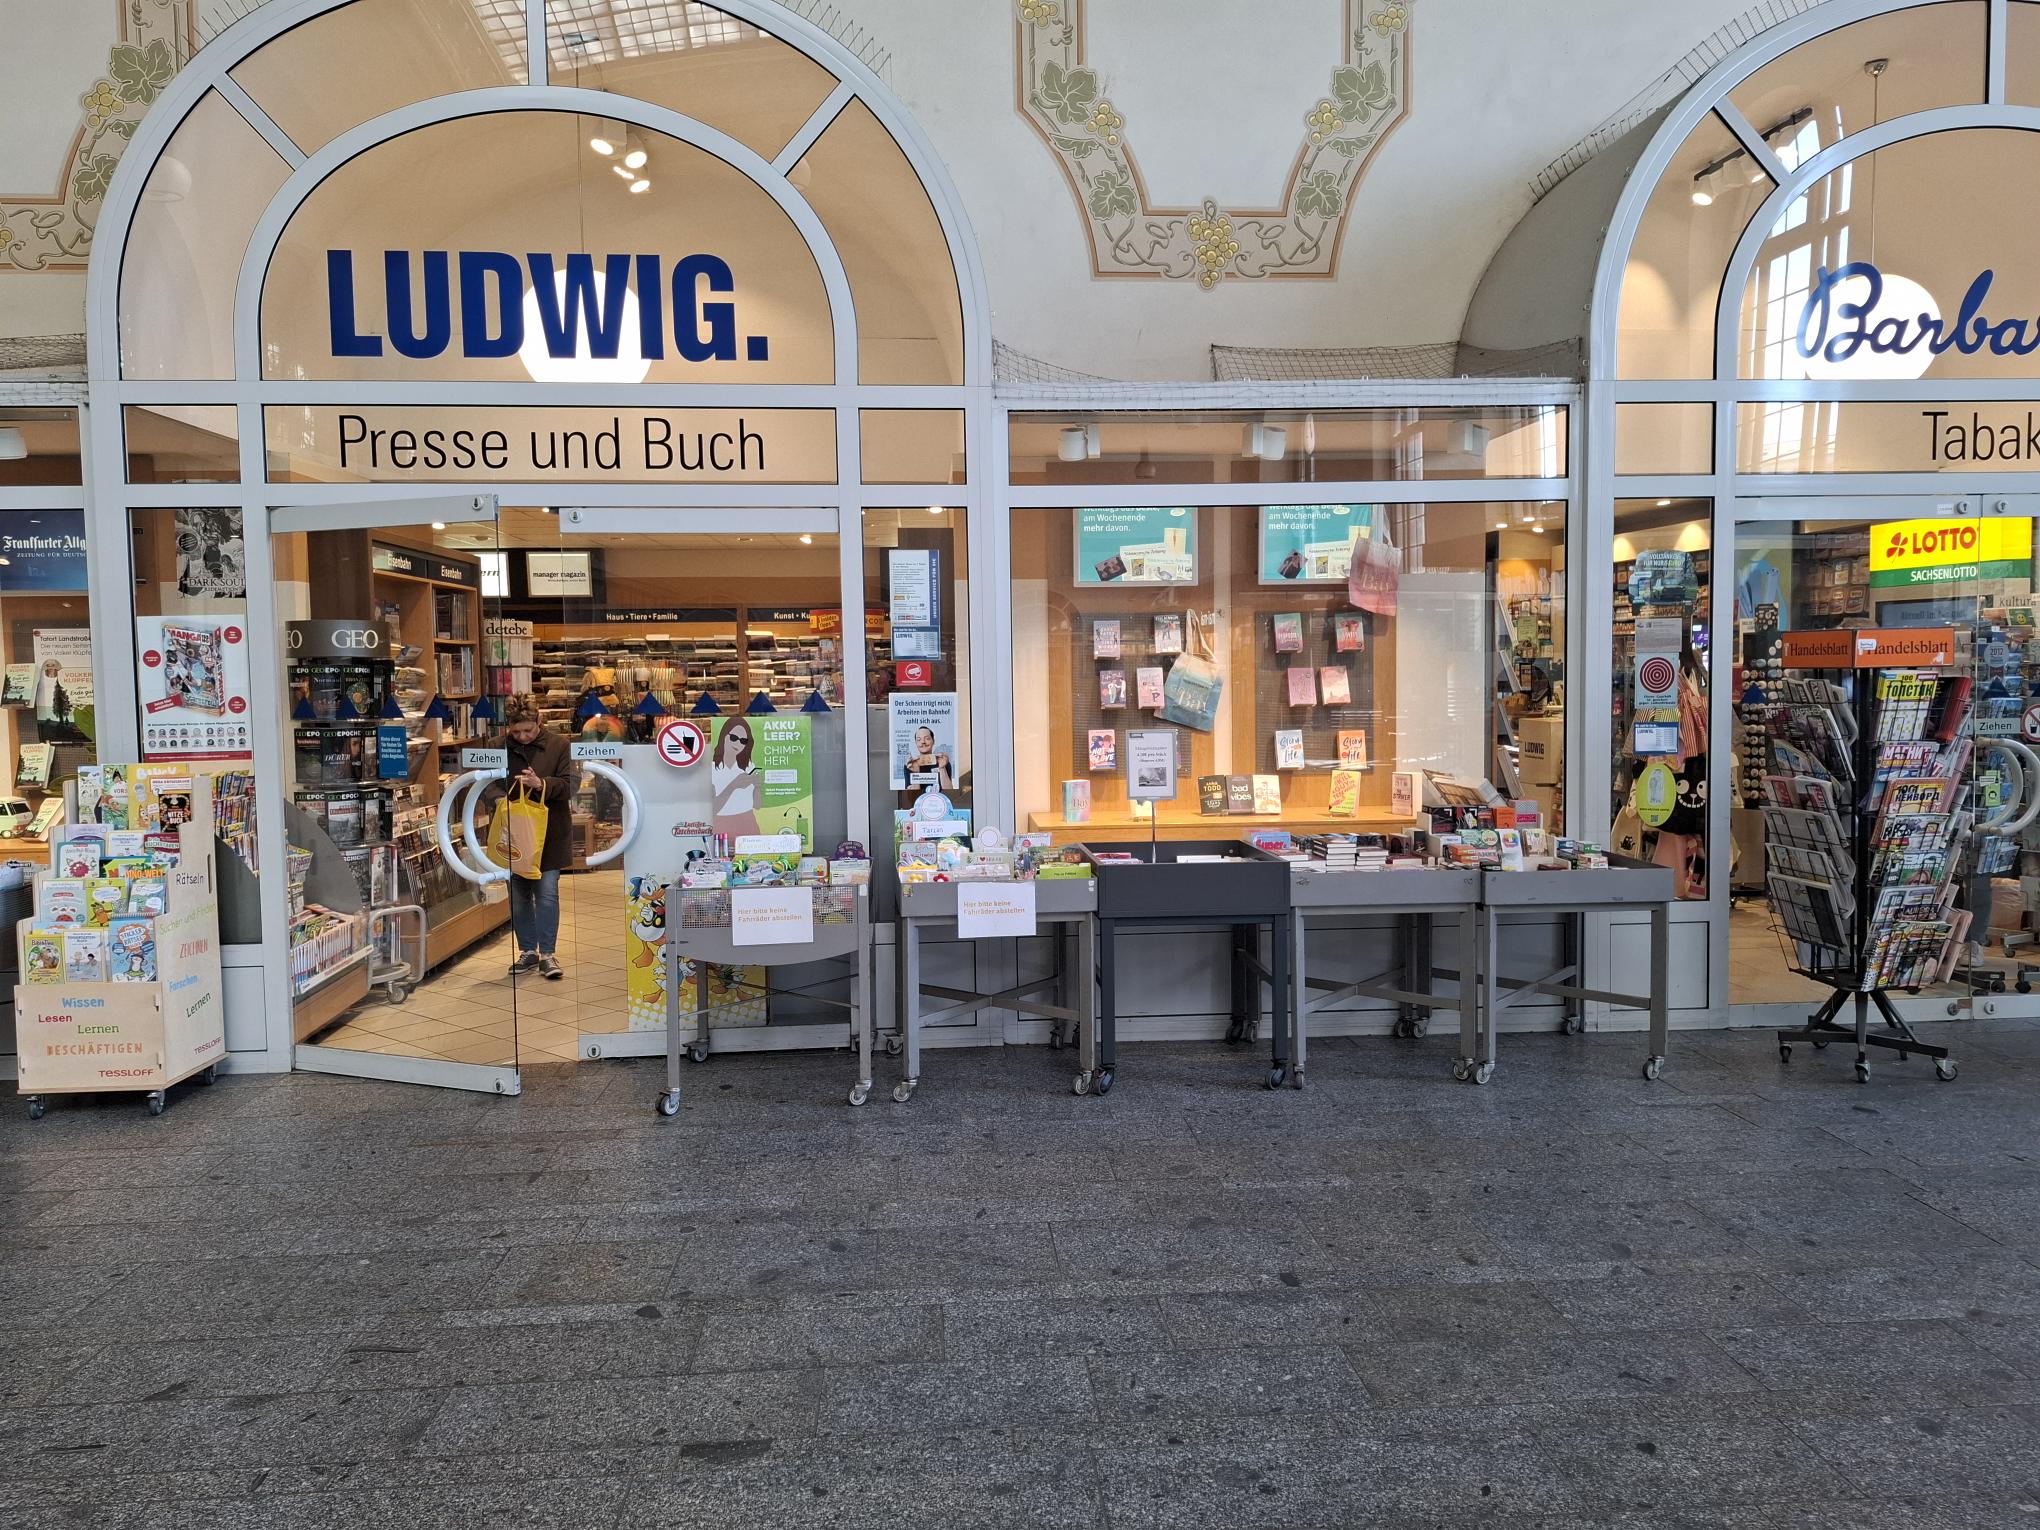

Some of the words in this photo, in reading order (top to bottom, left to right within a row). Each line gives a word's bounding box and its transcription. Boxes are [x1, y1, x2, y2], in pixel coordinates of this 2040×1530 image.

[326, 249, 769, 362] LUDWIG.
[1795, 261, 2040, 363] Barba
[337, 414, 509, 469] Presse
[530, 417, 621, 470] und
[643, 416, 766, 471] Buch
[1096, 513, 1146, 522] Wochenende
[1282, 512, 1331, 520] Wochenende
[1084, 524, 1104, 532] mehr
[1105, 524, 1131, 532] davon.
[1268, 522, 1289, 530] mehr
[1912, 526, 1977, 554] LOTTO
[387, 553, 412, 571] Eisenbahn
[441, 565, 462, 580] Eisenbahn
[533, 571, 559, 579] manager
[560, 570, 586, 578] magazin
[1911, 565, 1977, 582] SACHSENLOTTO
[189, 578, 218, 587] DARK
[606, 613, 625, 621] Haus
[629, 613, 648, 621] Tiere
[653, 613, 678, 621] Familie
[773, 612, 795, 620] Kunst
[485, 622, 528, 635] detebe
[331, 629, 379, 649] GEO
[1789, 641, 1849, 657] Handelsblatt
[928, 708, 951, 716] Bahnhof
[764, 721, 796, 730] AKKU
[905, 717, 919, 725] zahlt
[1980, 722, 2012, 731] Ziehen
[764, 731, 801, 742] LEER?
[577, 746, 616, 756] Ziehen
[764, 745, 806, 755] CHIMPY
[1524, 741, 1545, 755] LUDWIG
[469, 753, 502, 764] Ziehen
[1231, 784, 1249, 792] bad
[1230, 792, 1252, 801] vibes
[674, 826, 713, 835] Taschenbuch
[176, 872, 204, 886] Rätseln
[160, 918, 183, 936] Suchen
[169, 974, 198, 993] Forschen
[62, 997, 105, 1009] Wissen
[186, 992, 212, 1018] Lernen
[38, 1014, 73, 1024] Lesen
[77, 1024, 120, 1035] Lernen
[46, 1042, 143, 1056] BESCHÄFTIGEN
